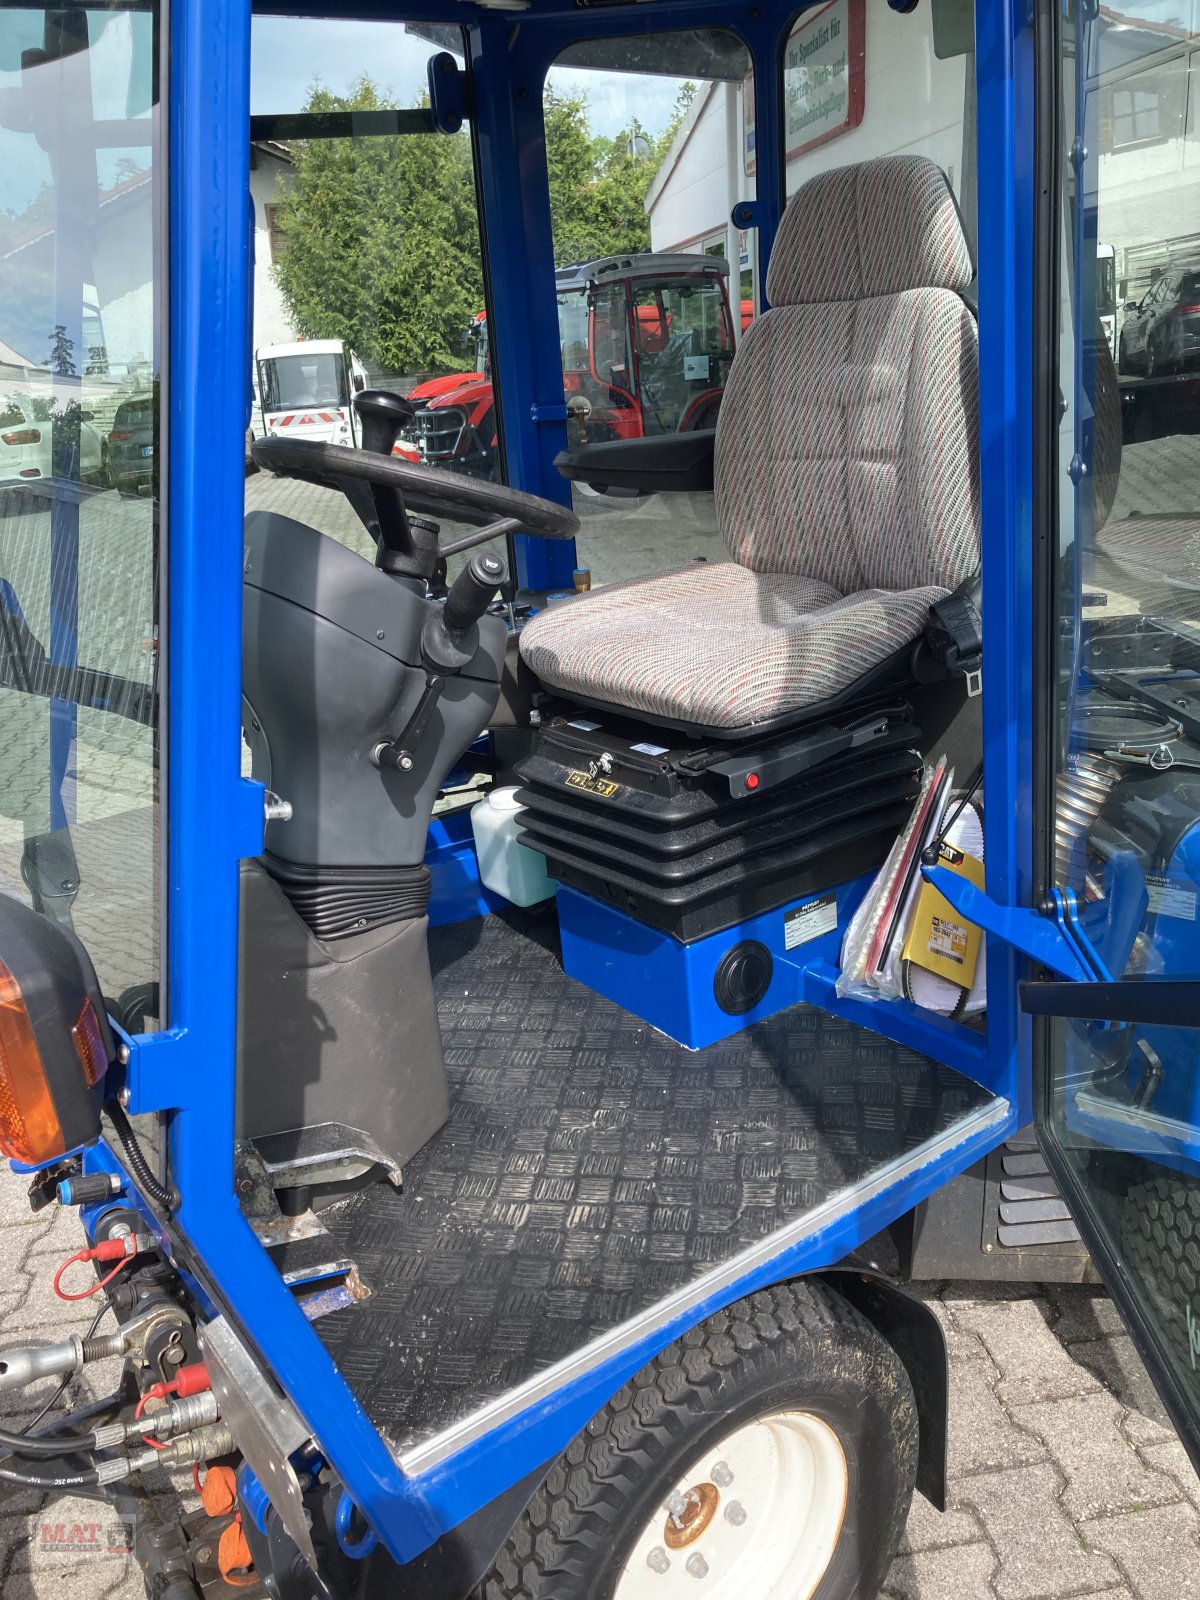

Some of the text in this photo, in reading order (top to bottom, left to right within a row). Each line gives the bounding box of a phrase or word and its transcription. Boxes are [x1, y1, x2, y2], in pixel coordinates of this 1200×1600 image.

[799, 25, 829, 64] Spezialist
[830, 16, 841, 40] für
[833, 51, 845, 77] und
[789, 91, 845, 136] Grundstückspflege
[939, 842, 957, 861] CAT
